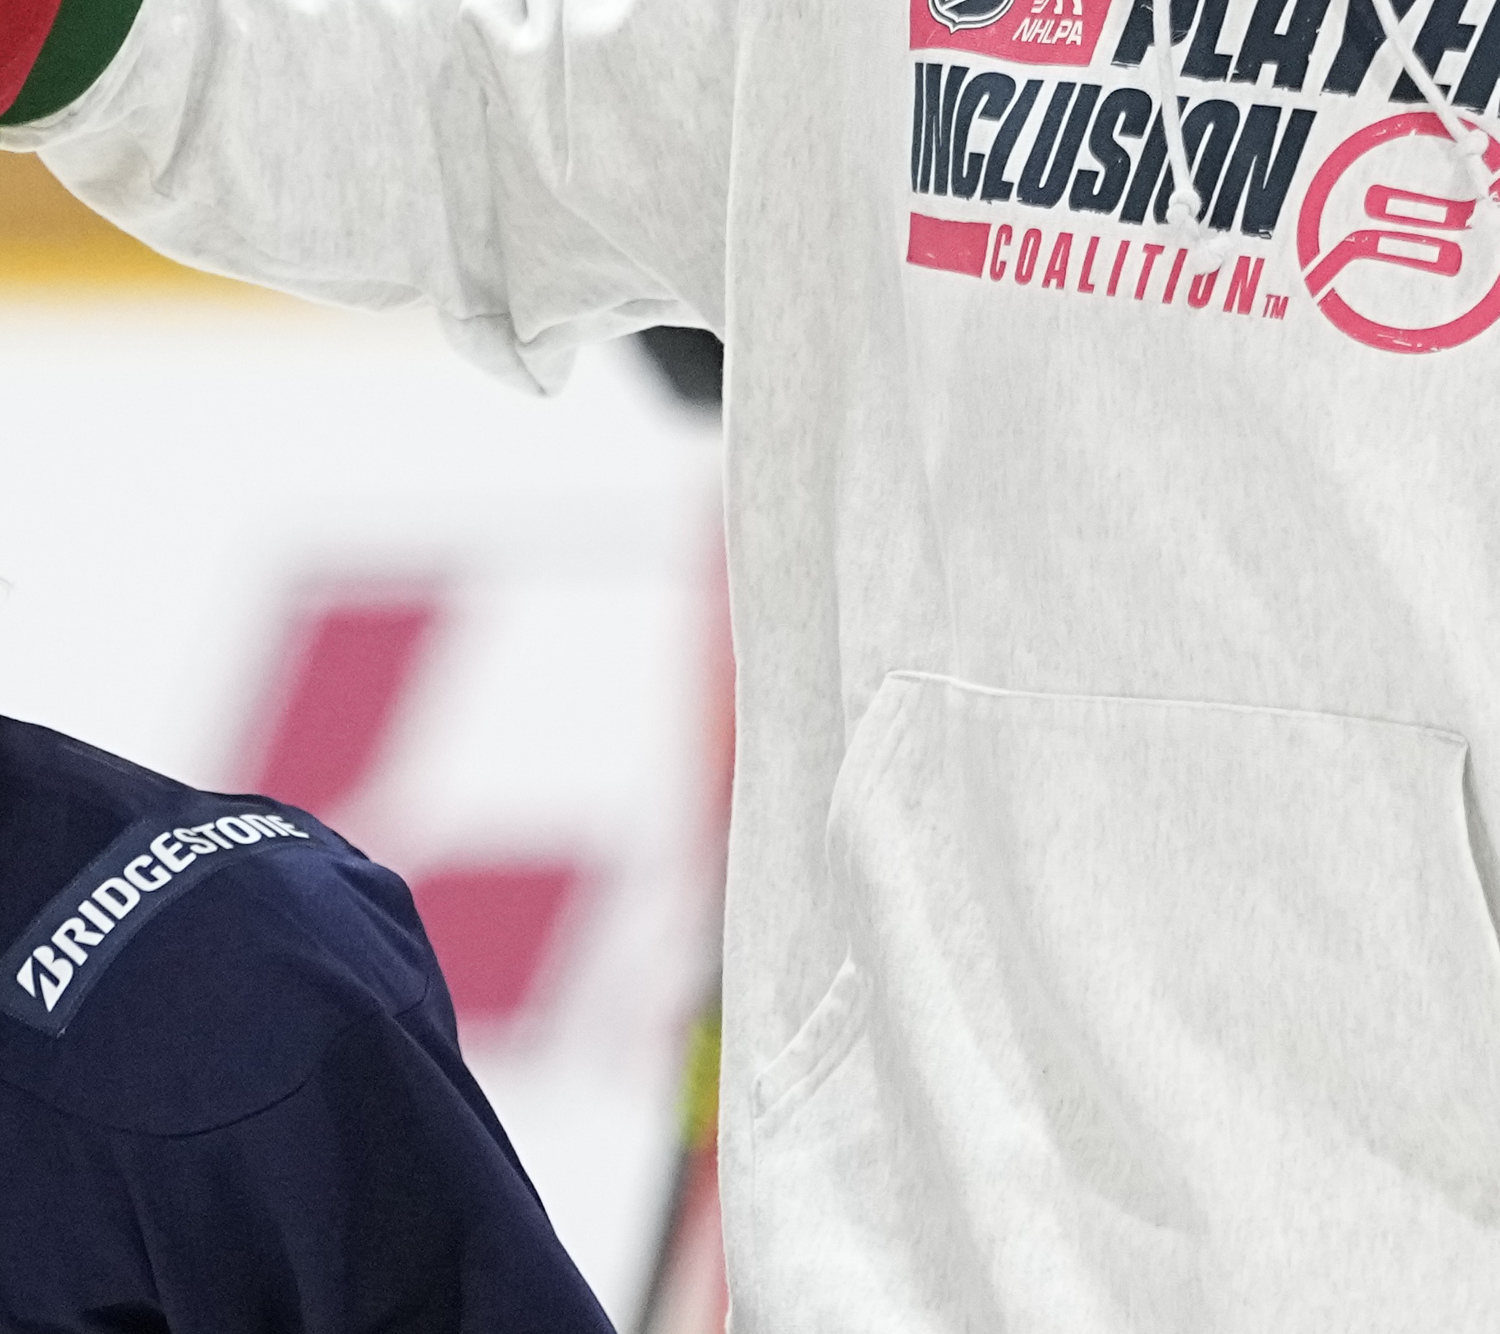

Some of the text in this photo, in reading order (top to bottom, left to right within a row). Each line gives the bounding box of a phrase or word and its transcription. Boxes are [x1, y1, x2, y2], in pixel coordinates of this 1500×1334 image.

[1012, 17, 1083, 45] NHLPA
[910, 62, 1317, 240] INCLUSION
[16, 813, 310, 1013] BRIDGESTONE
